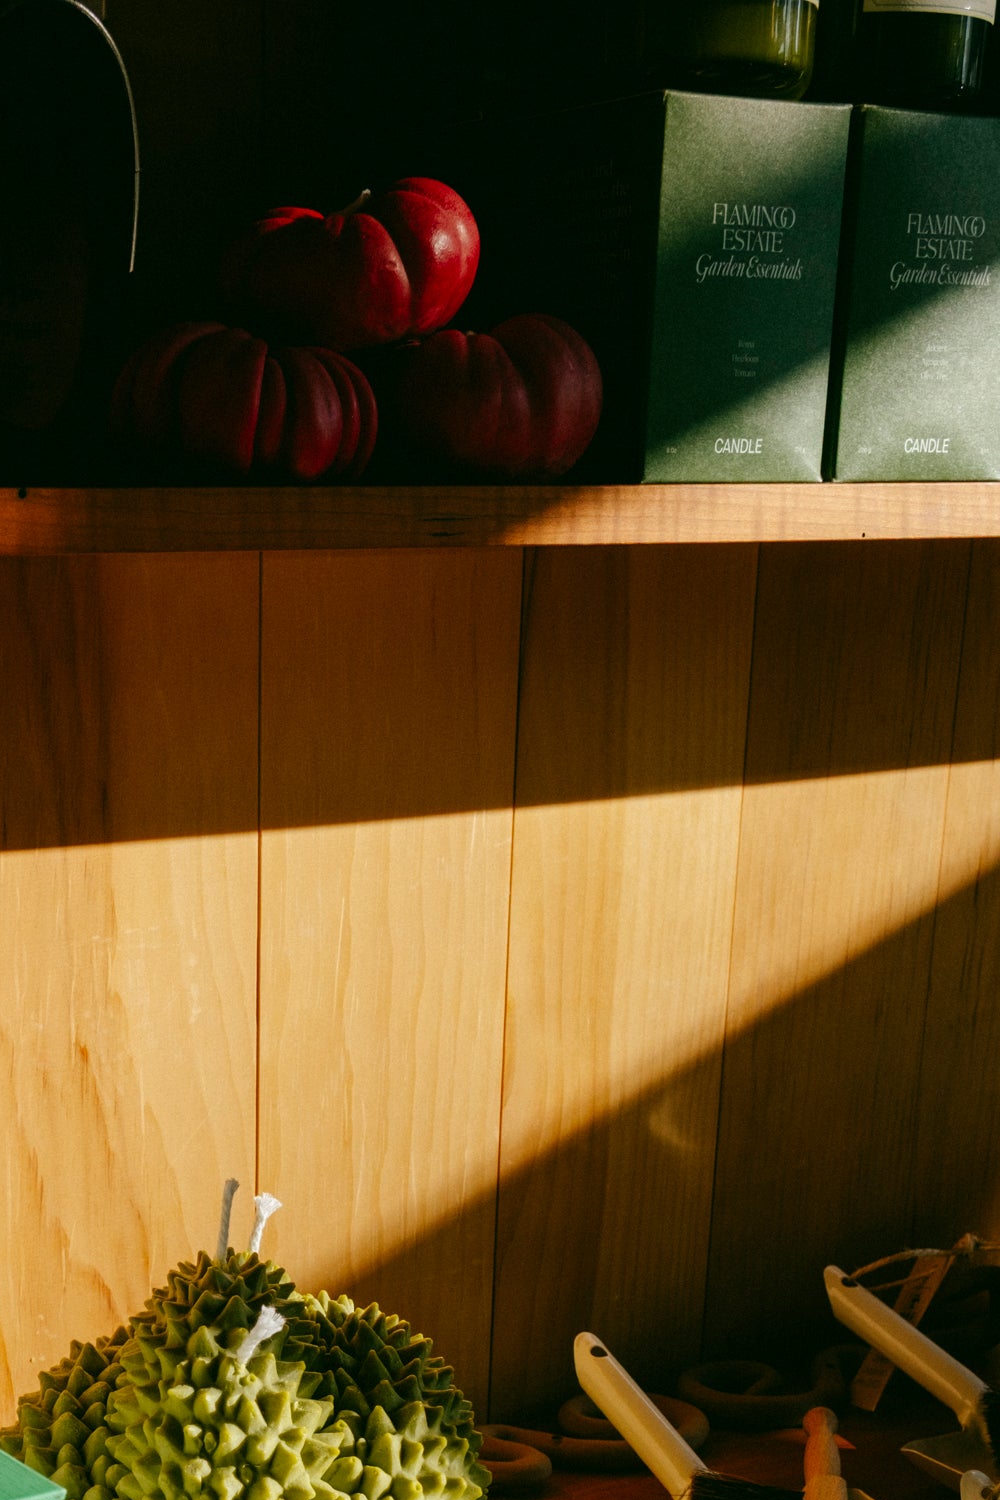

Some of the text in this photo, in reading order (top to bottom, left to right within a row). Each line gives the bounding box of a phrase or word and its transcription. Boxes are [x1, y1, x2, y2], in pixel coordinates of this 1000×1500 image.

[712, 202, 796, 229] FLAMINGO
[906, 213, 986, 238] FLAMINGO
[722, 229, 784, 253] ESTATE
[915, 238, 974, 261] ESTATE
[695, 254, 803, 283] Garden Essentials
[890, 261, 992, 290] Garden Essentials
[714, 438, 763, 454] CANDLE
[904, 438, 950, 454] CANDLE
